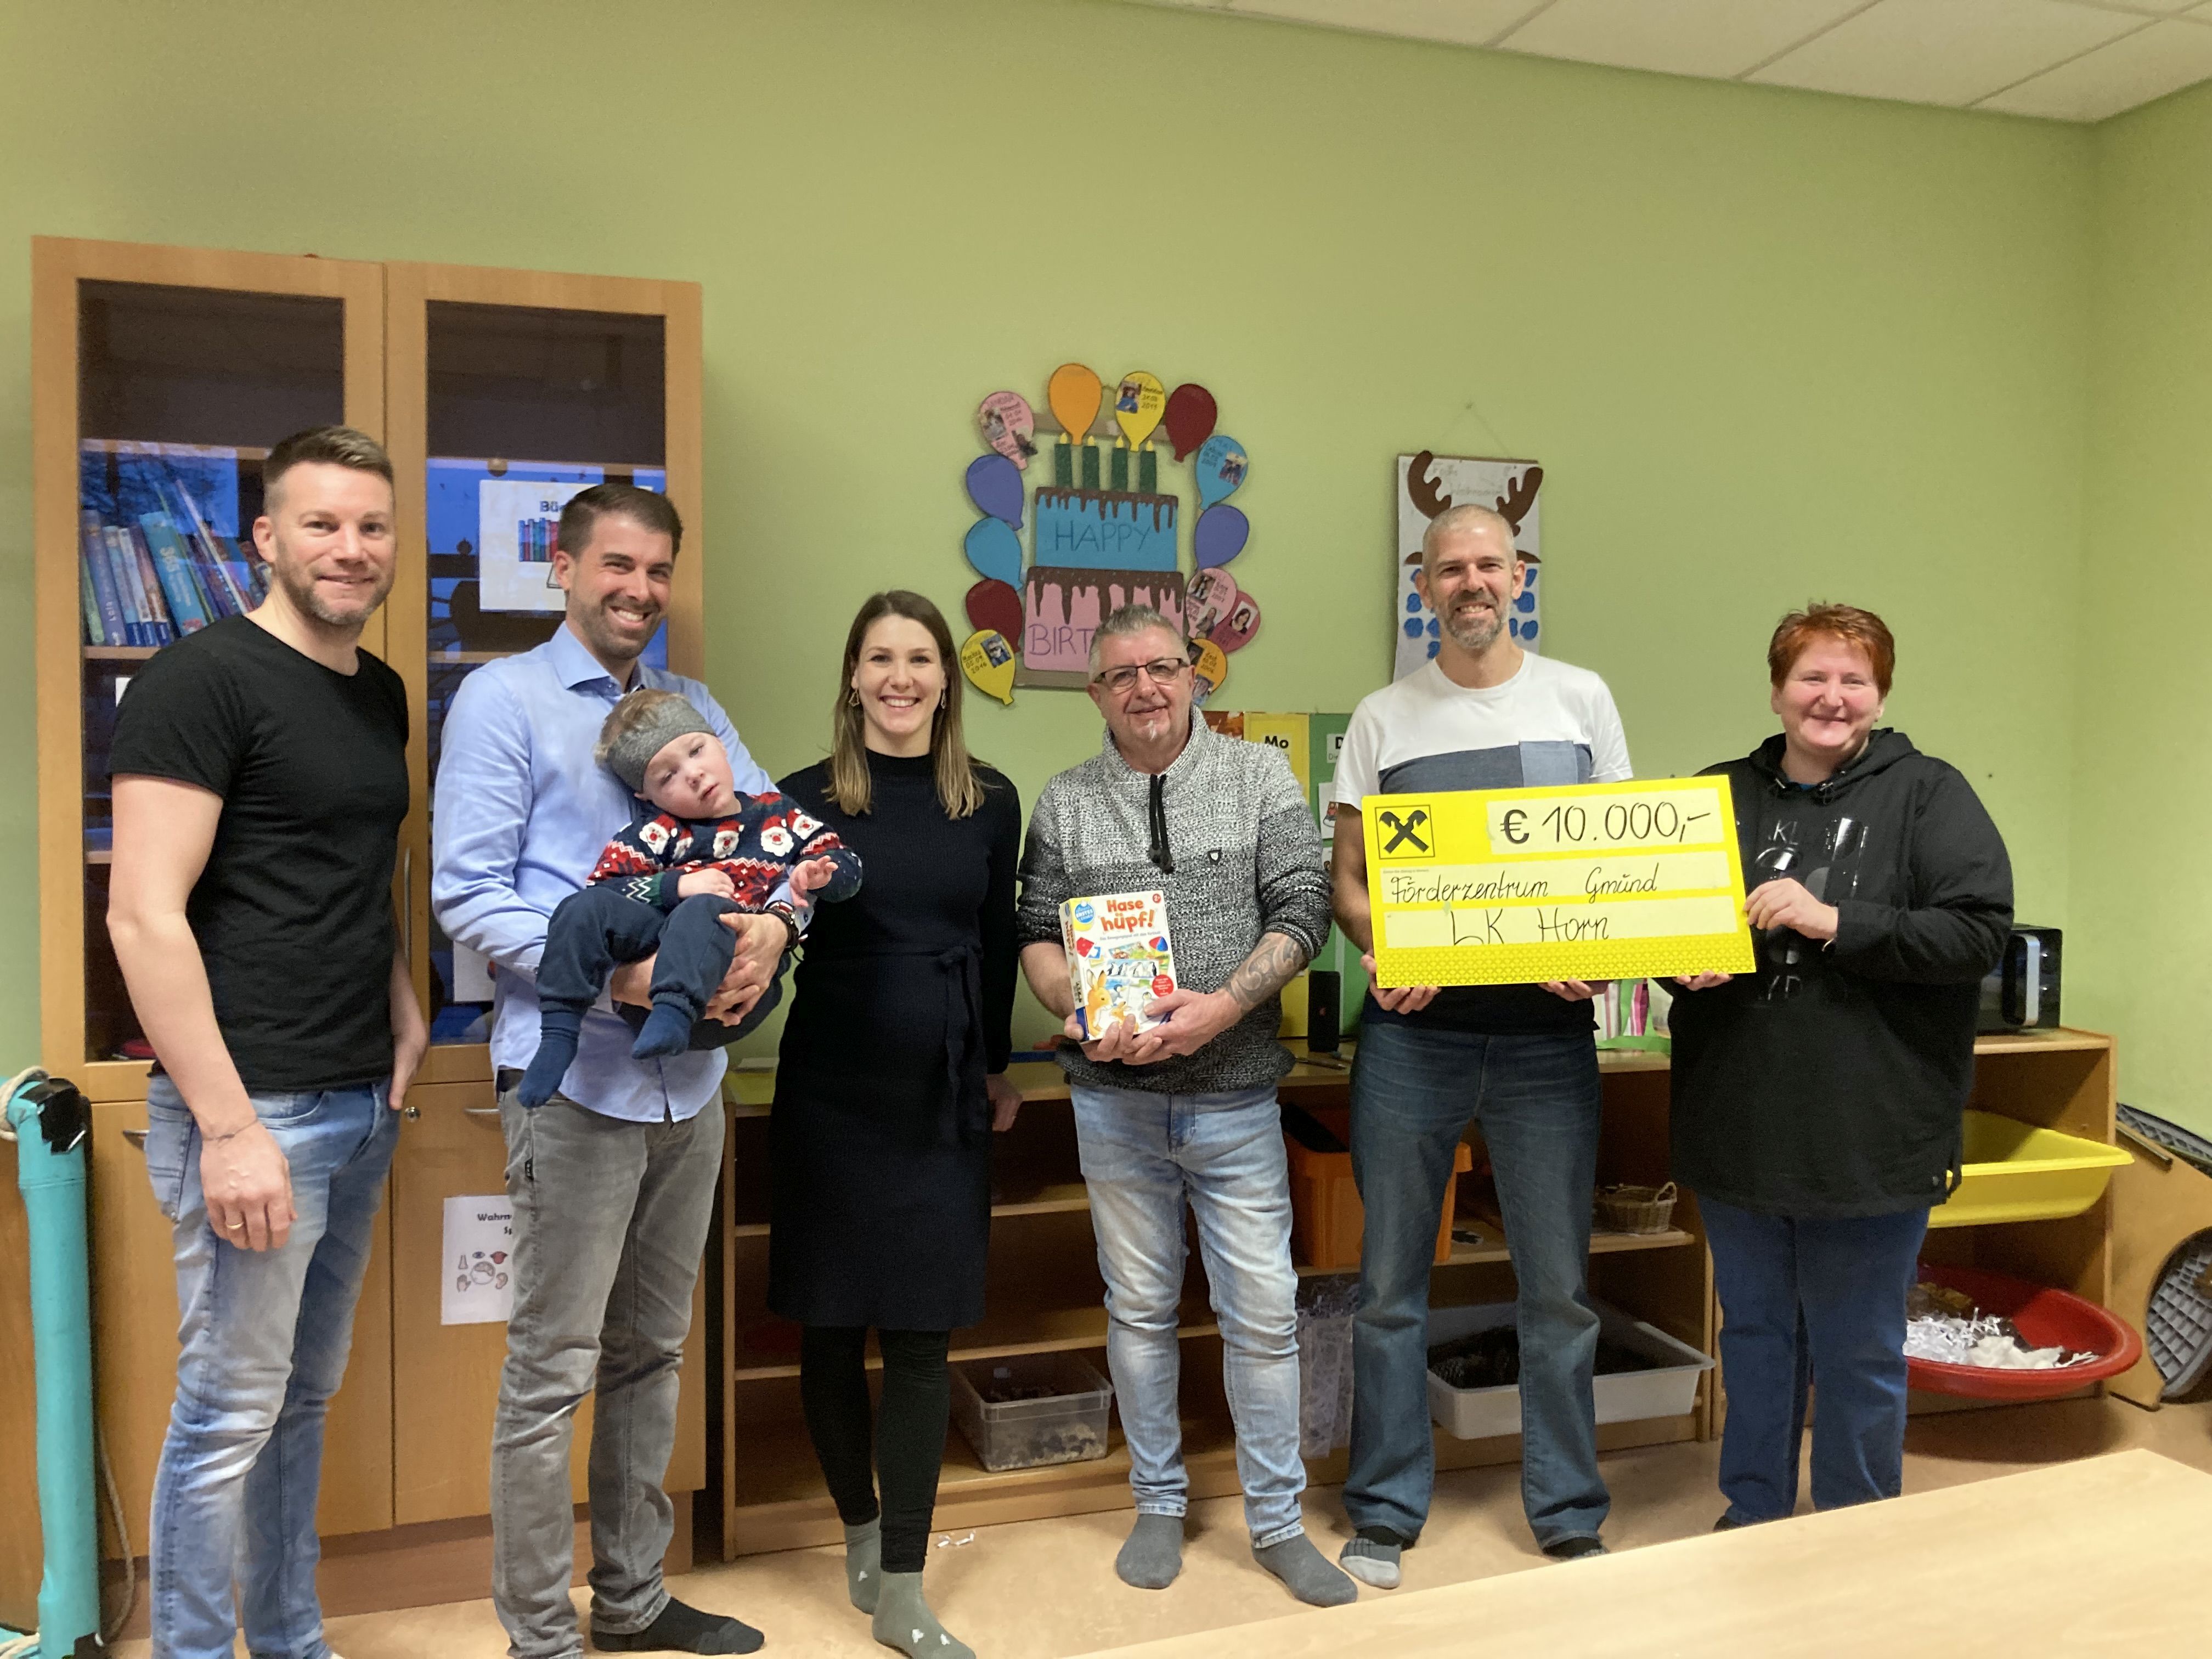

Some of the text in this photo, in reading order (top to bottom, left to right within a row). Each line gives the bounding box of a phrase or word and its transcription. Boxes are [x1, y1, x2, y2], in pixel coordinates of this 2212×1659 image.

[1055, 520, 1150, 552] HAPPY
[1264, 736, 1289, 749] Mo
[1500, 809, 1530, 844] €
[1391, 862, 1658, 904] Förderzentrum Gmünd
[1100, 909, 1155, 933] hüpf!
[1106, 899, 1144, 913] Hase
[1537, 907, 1610, 943] Horn
